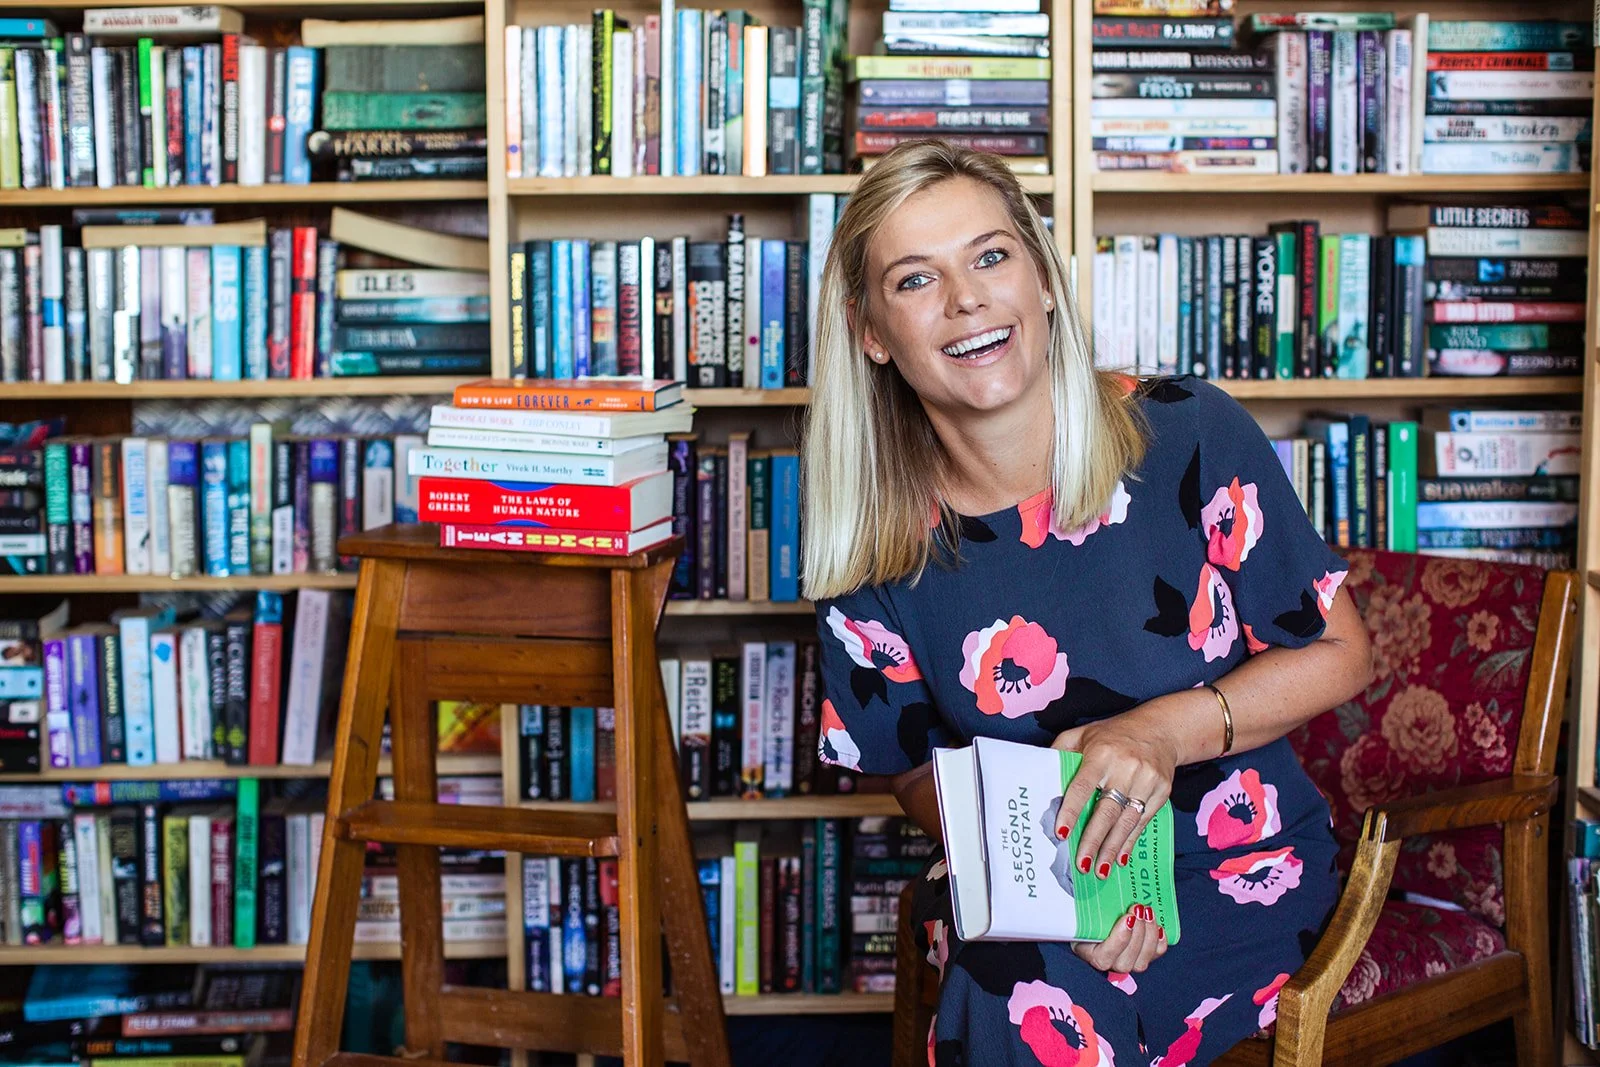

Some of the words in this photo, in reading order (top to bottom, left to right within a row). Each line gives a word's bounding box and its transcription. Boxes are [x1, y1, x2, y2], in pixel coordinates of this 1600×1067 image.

[1139, 82, 1194, 97] FROST
[1502, 120, 1560, 137] broken
[1435, 206, 1475, 226] LITTLE
[1475, 207, 1530, 227] SECRETS
[364, 275, 415, 291] ILES
[1256, 244, 1275, 315] YORKE
[1510, 355, 1554, 369] SECOND
[1556, 356, 1578, 368] LIFE
[461, 396, 480, 405] HOW
[482, 397, 493, 405] TO
[494, 397, 513, 406] LIVE
[516, 394, 569, 409] FOREVER
[423, 454, 498, 473] Together
[506, 463, 529, 472] Vivek
[532, 464, 541, 473] H.
[543, 465, 574, 476] Murthy
[429, 491, 470, 502] ROBERT
[1424, 482, 1461, 500] sue
[1463, 480, 1526, 499] walker
[427, 502, 471, 513] GREENE
[501, 495, 523, 505] THE
[526, 496, 555, 506] LAWS
[557, 497, 571, 507] OF
[493, 505, 533, 516] HUMAN
[536, 506, 580, 518] NATURE
[457, 530, 524, 546] TEAM
[526, 533, 613, 549] HUMAN
[687, 676, 709, 730] Reichs
[823, 821, 836, 867] KAREN
[1001, 828, 1009, 852] THE
[1008, 798, 1024, 883] SECOND
[1018, 786, 1037, 899] MOUNTAIN
[1152, 838, 1162, 906] INTERNATIONAL
[1129, 872, 1138, 899] QUEST
[822, 868, 836, 929] ROBARDS
